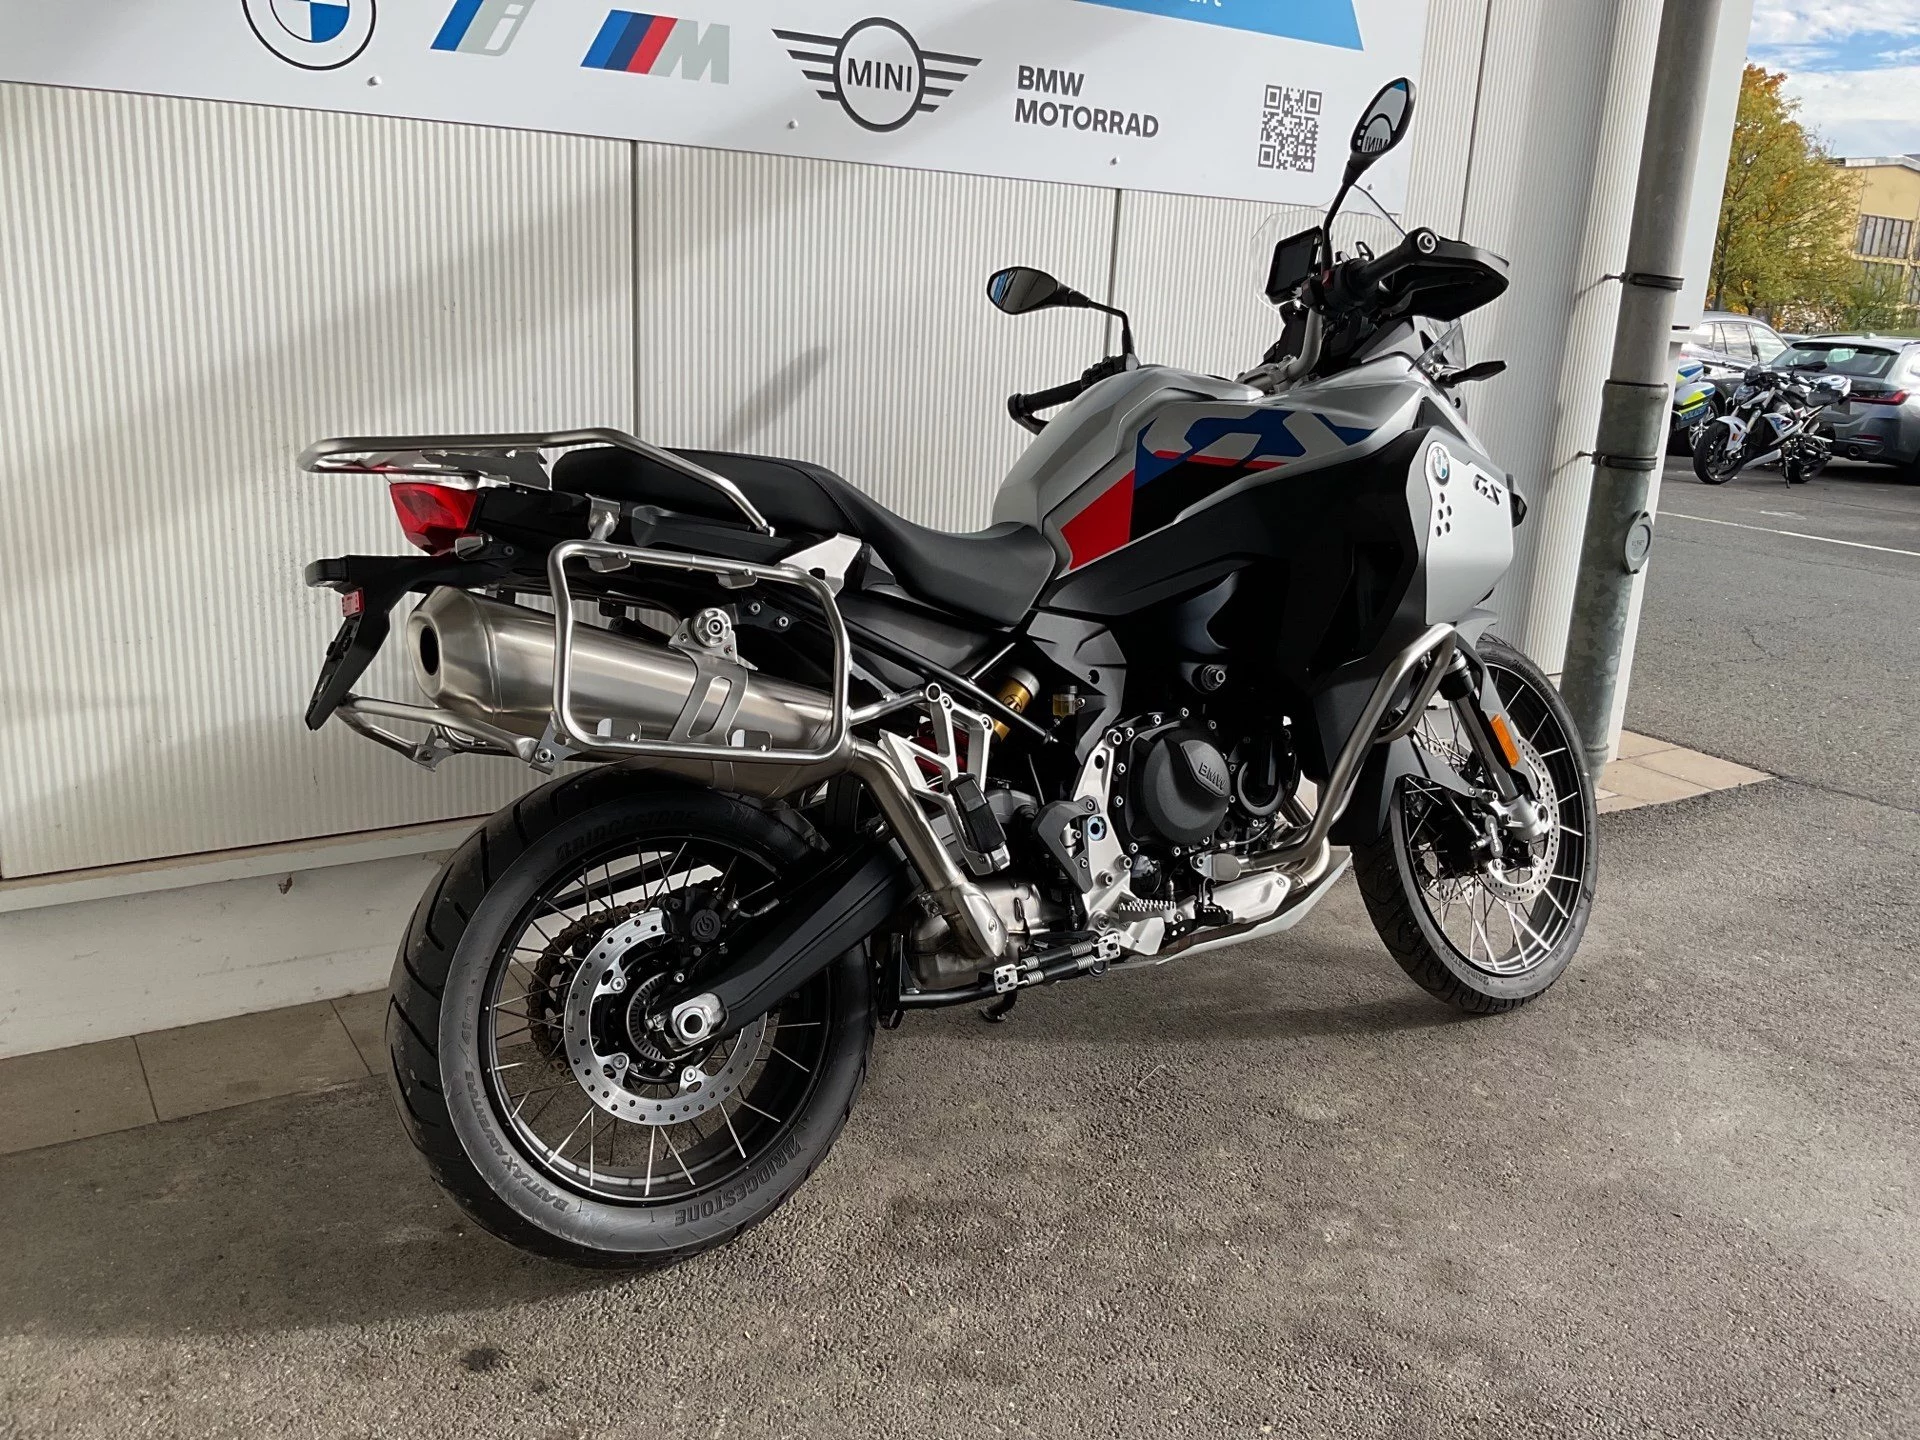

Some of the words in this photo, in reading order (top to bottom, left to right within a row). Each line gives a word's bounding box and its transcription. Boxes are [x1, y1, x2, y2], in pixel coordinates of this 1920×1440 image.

[847, 57, 912, 93] MINI
[1017, 64, 1085, 97] BMW
[1014, 97, 1159, 139] MOTORRAD
[1198, 761, 1227, 791] BMW
[464, 1070, 509, 1159] ADVENTURE
[501, 1155, 570, 1213] BATTLAX
[673, 1133, 803, 1228] BRIDGESTONE
